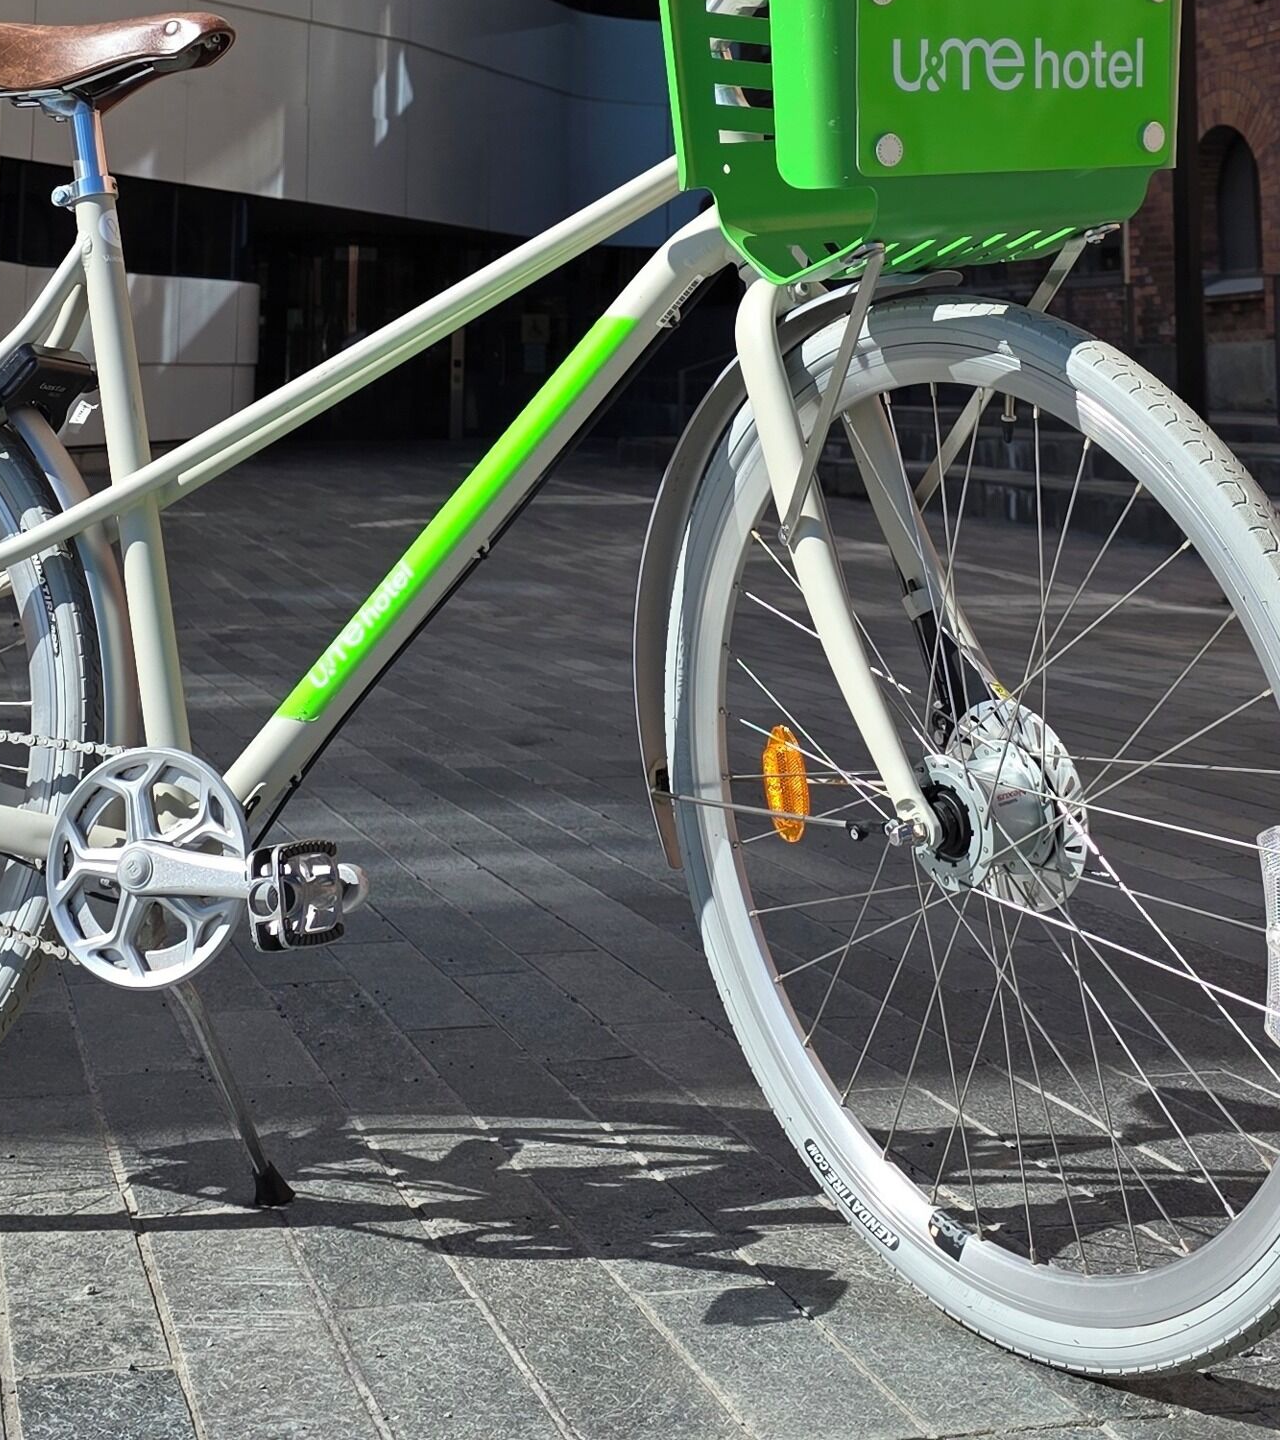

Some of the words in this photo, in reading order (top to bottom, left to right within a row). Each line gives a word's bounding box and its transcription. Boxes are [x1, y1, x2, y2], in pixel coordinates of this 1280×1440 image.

[1034, 37, 1144, 90] hotel
[359, 560, 414, 628] hotel
[806, 1143, 898, 1248] KENDATIRE.COM
